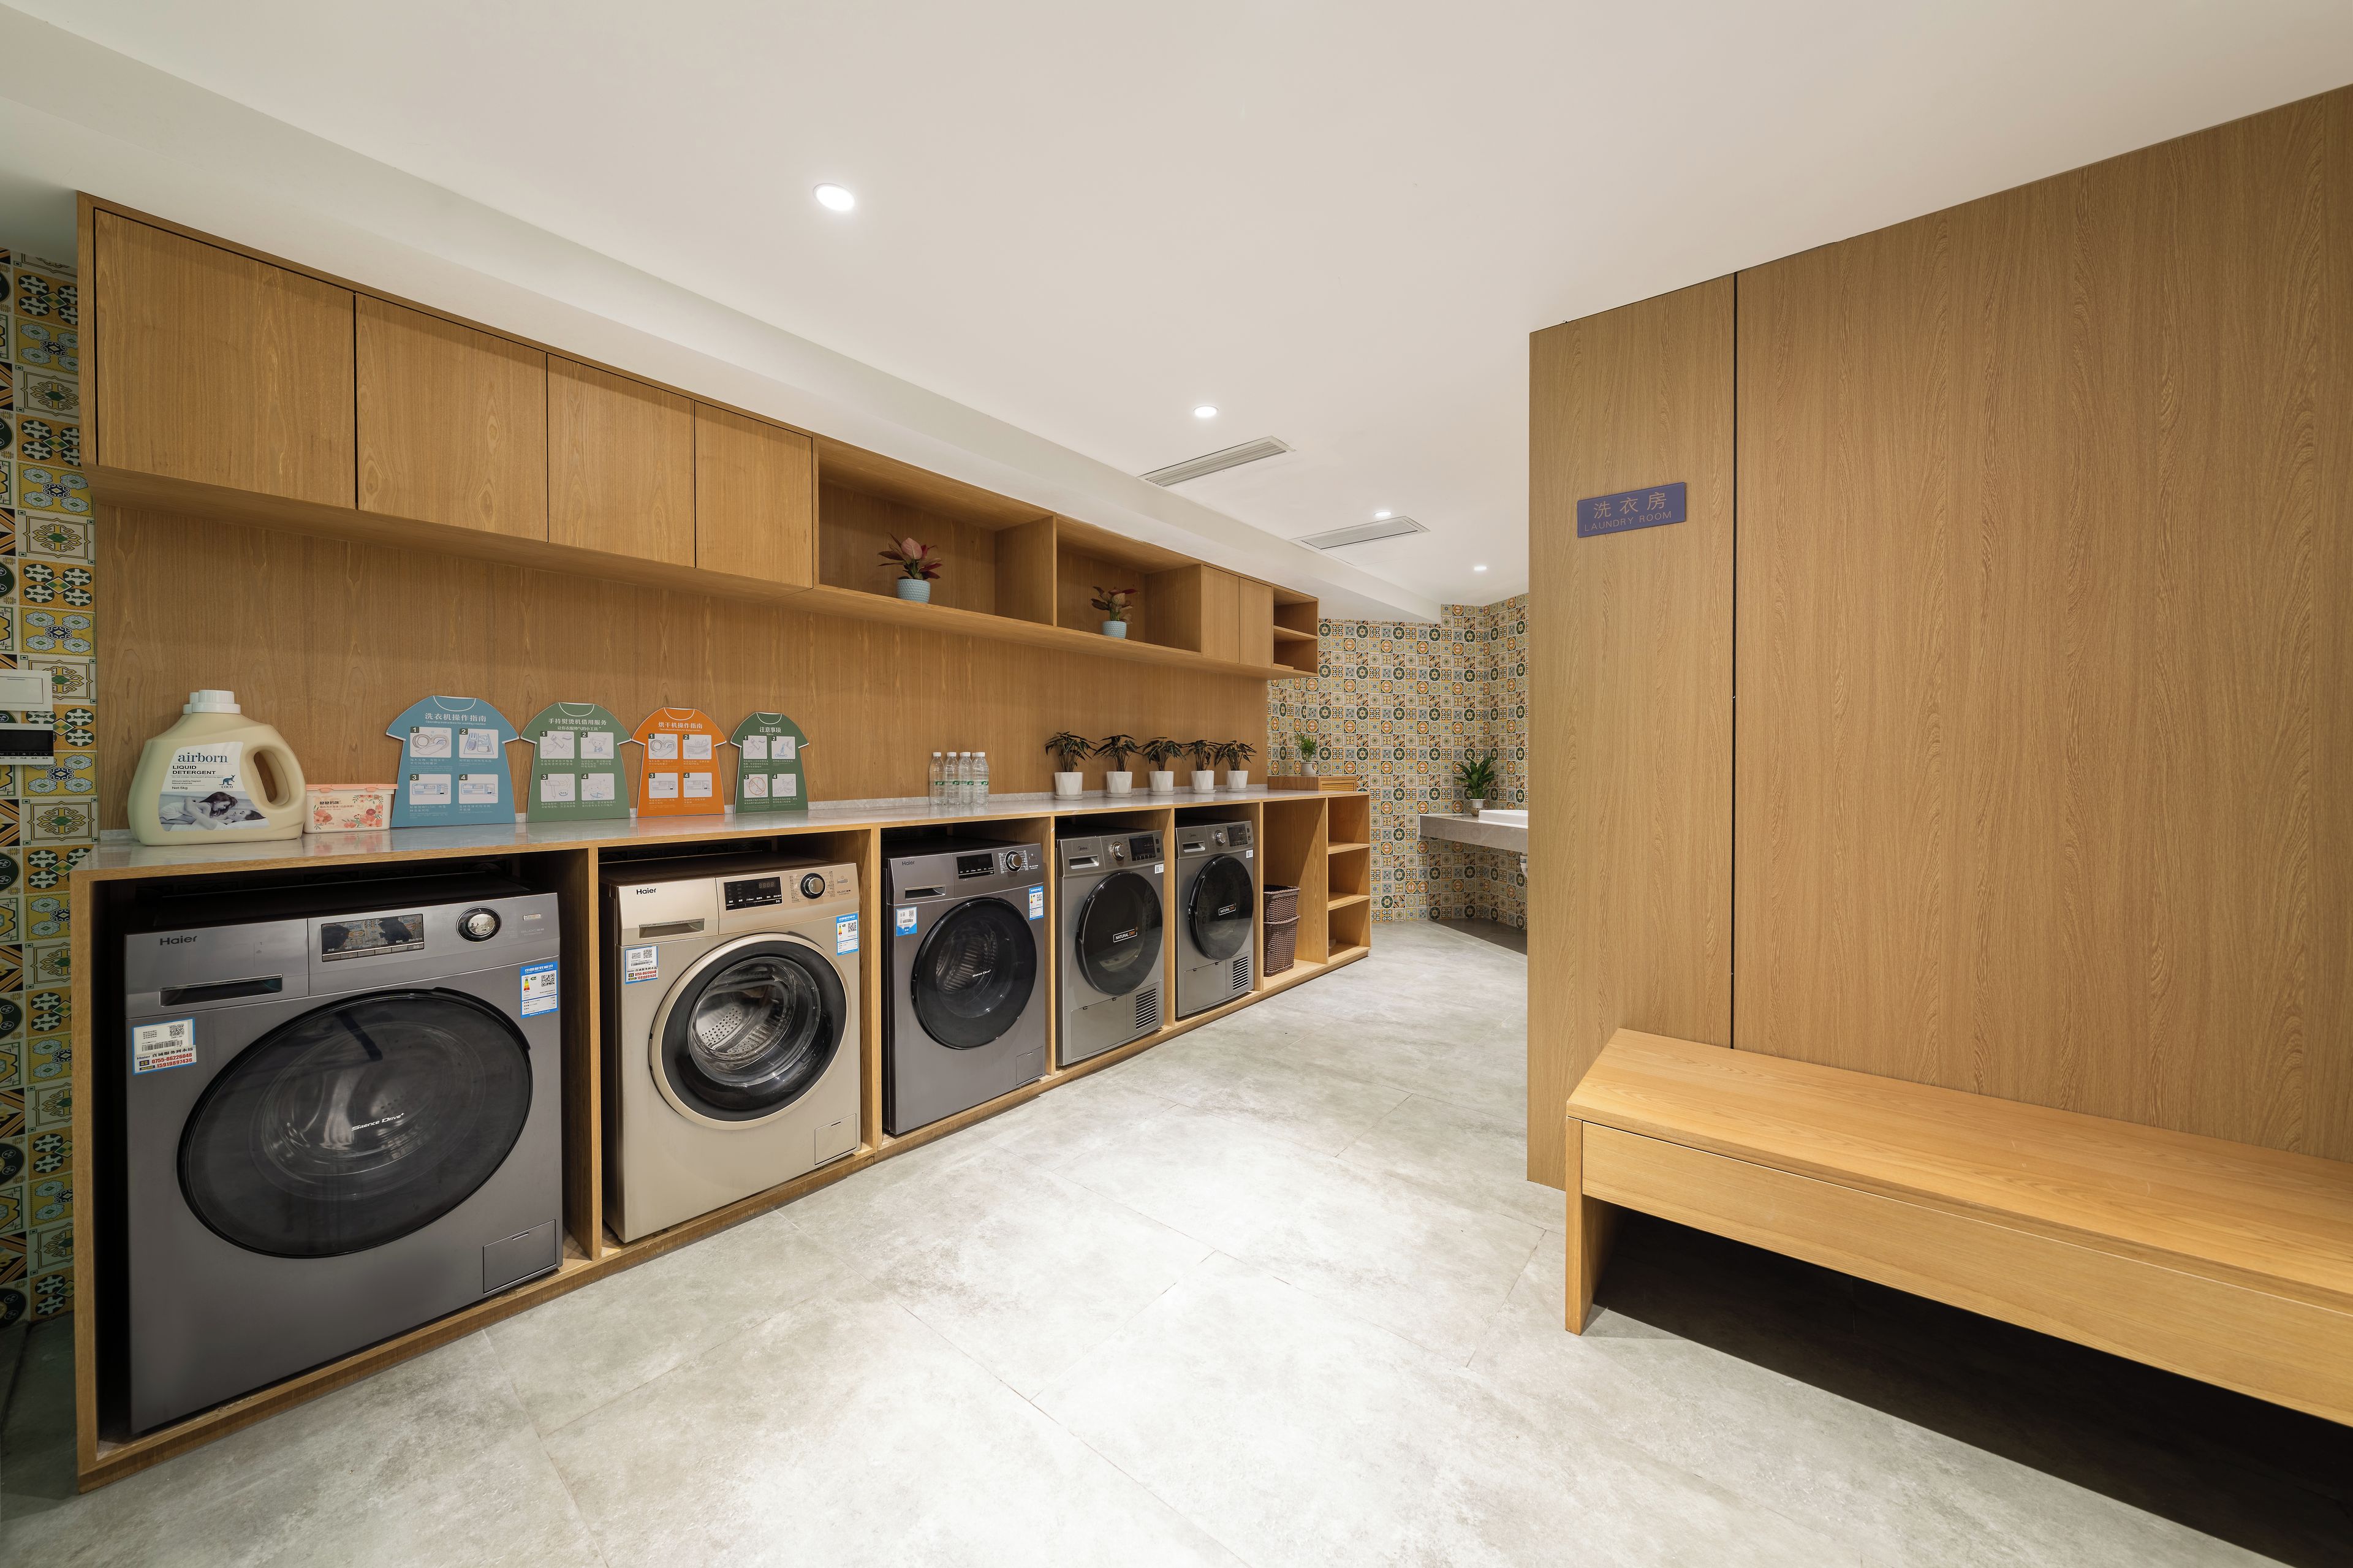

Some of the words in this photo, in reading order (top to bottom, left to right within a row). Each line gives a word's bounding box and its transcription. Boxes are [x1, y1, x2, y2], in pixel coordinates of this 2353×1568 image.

[1594, 492, 1667, 519] 洗衣房
[1585, 517, 1634, 532] LAUNDRY
[1639, 510, 1672, 523] ROOM
[425, 713, 486, 722] 洗衣机操作指南
[178, 752, 228, 763] airborn
[159, 935, 197, 946] Haier
[152, 1047, 193, 1058] 真诚服务到永远
[151, 1053, 193, 1064] 0755-86226048
[156, 1058, 193, 1068] 15919897436
[351, 1120, 380, 1131] Silence
